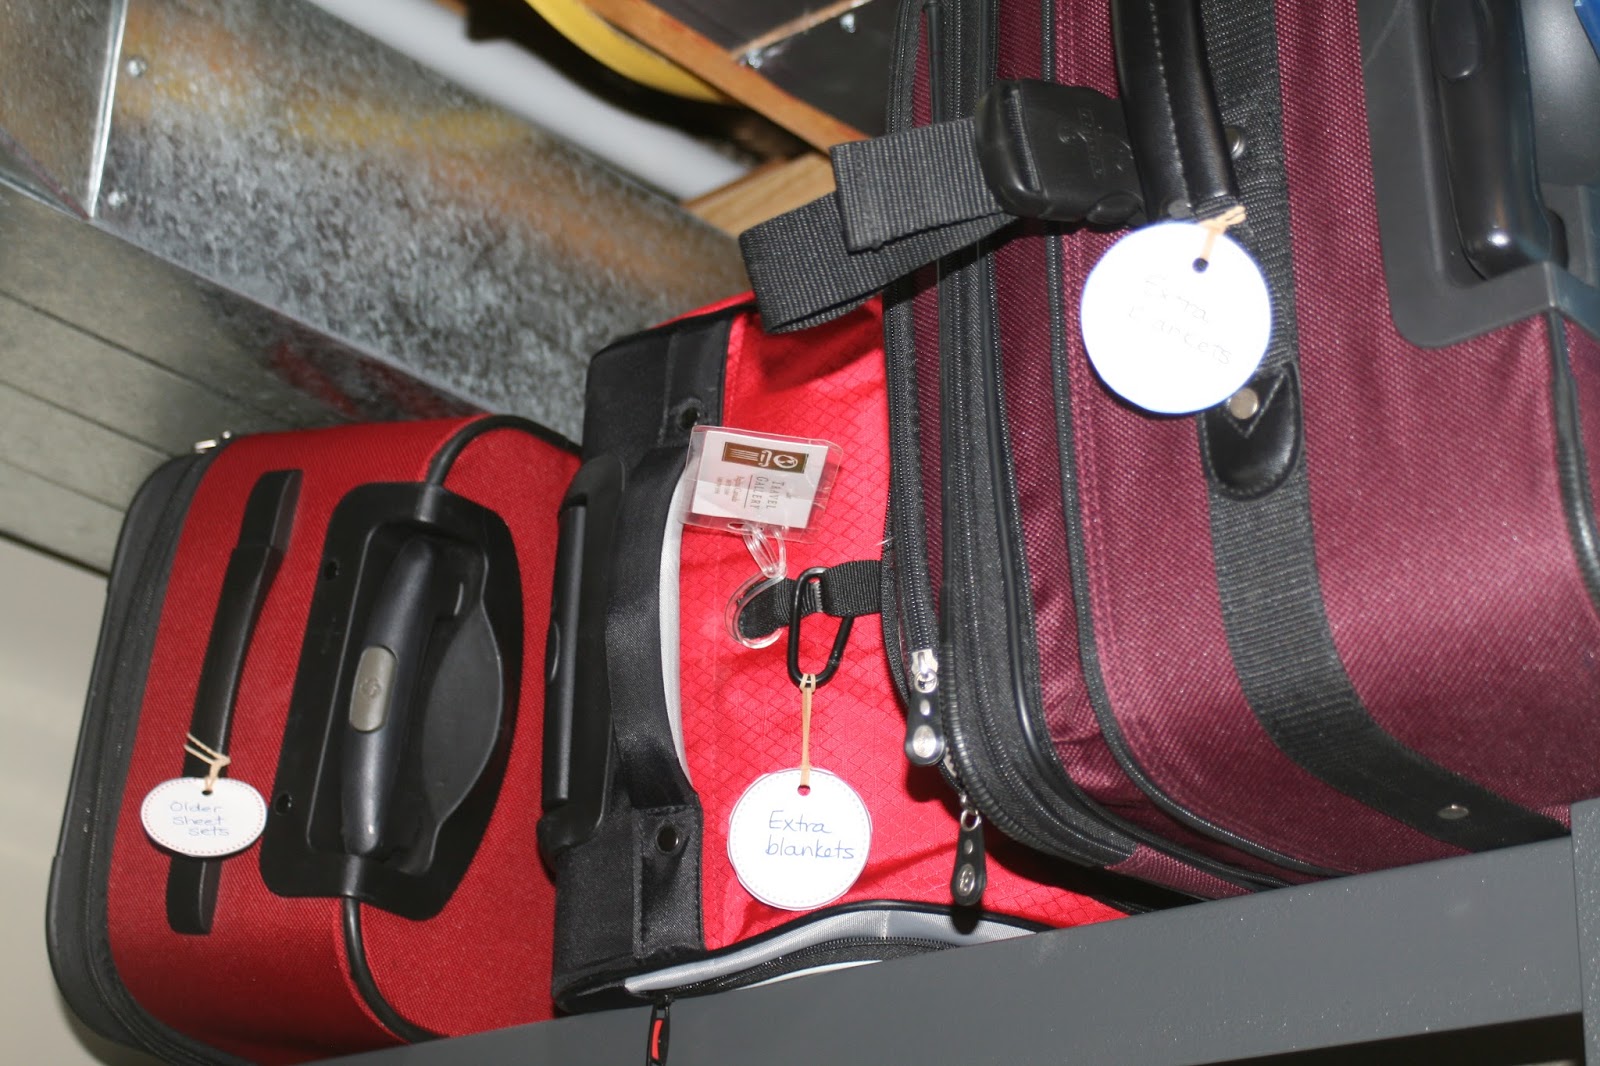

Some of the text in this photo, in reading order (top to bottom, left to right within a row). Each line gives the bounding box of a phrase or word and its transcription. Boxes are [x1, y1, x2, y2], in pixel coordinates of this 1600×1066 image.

[750, 476, 769, 510] GALLERY
[766, 481, 785, 510] TRAVEL
[170, 801, 222, 812] Older
[768, 809, 832, 834] Extra
[765, 834, 855, 860] blankets
